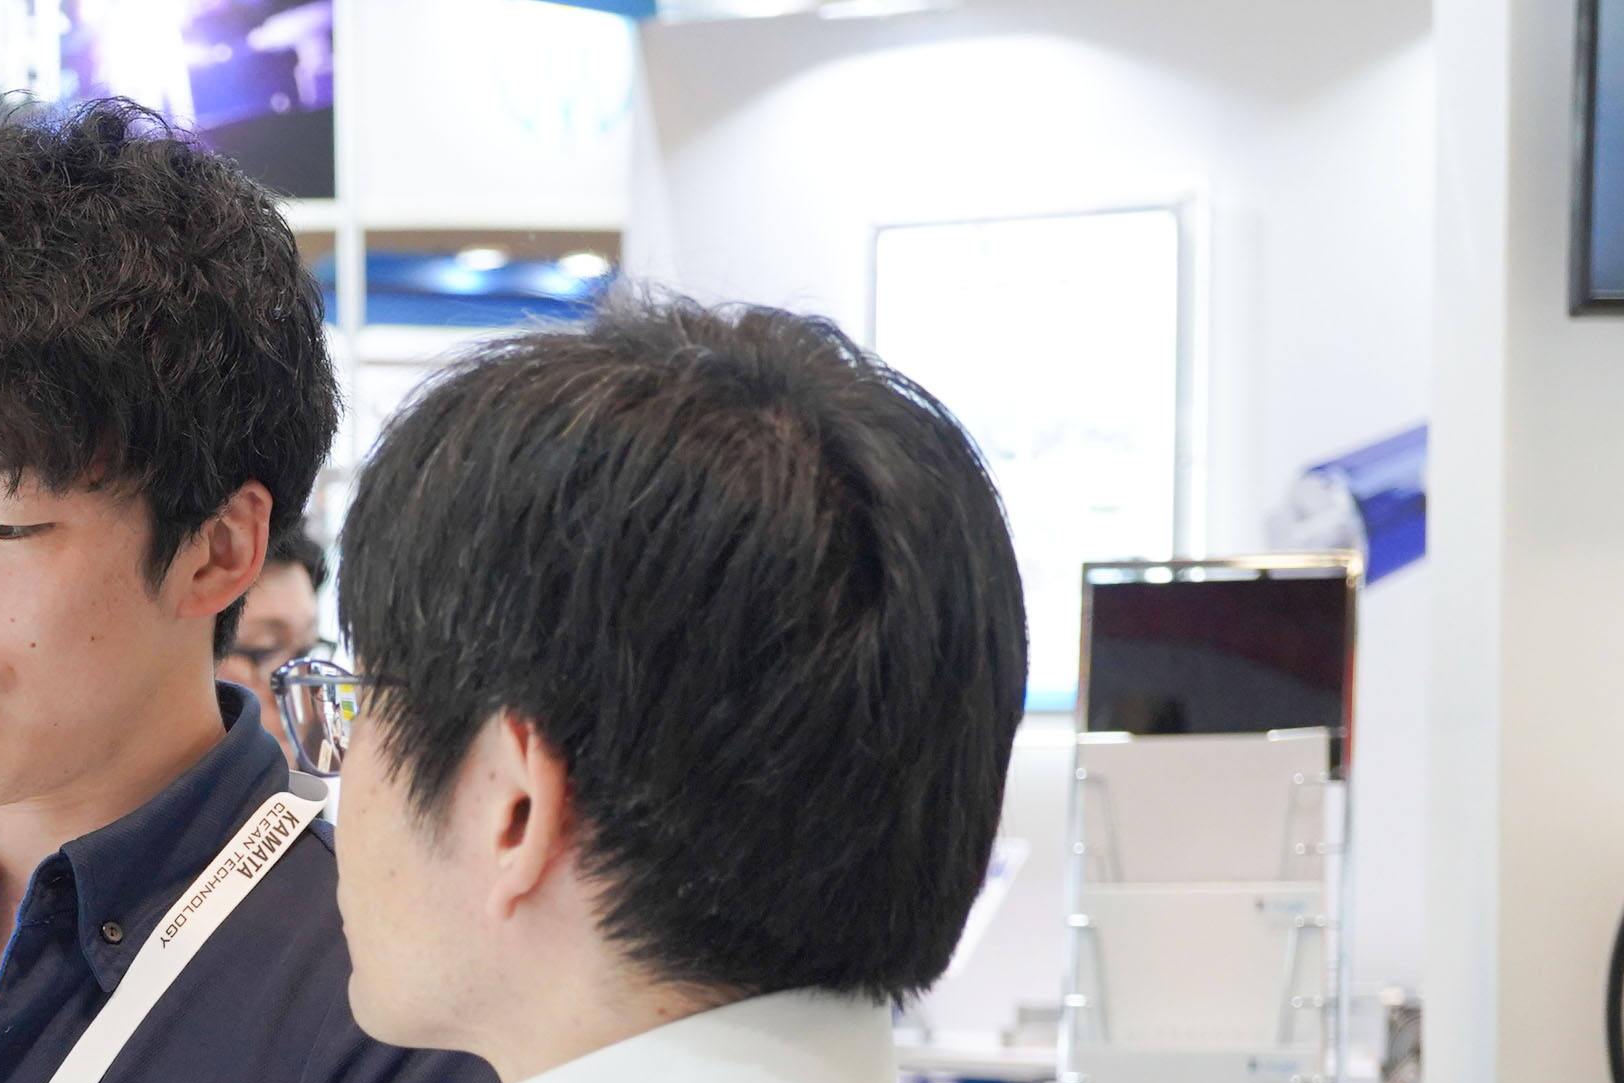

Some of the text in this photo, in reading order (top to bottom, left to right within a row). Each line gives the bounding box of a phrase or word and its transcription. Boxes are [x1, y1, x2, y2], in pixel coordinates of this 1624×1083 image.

[160, 802, 285, 949] CLEAN TECHNOLOGY
[237, 811, 300, 879] KAMATA
